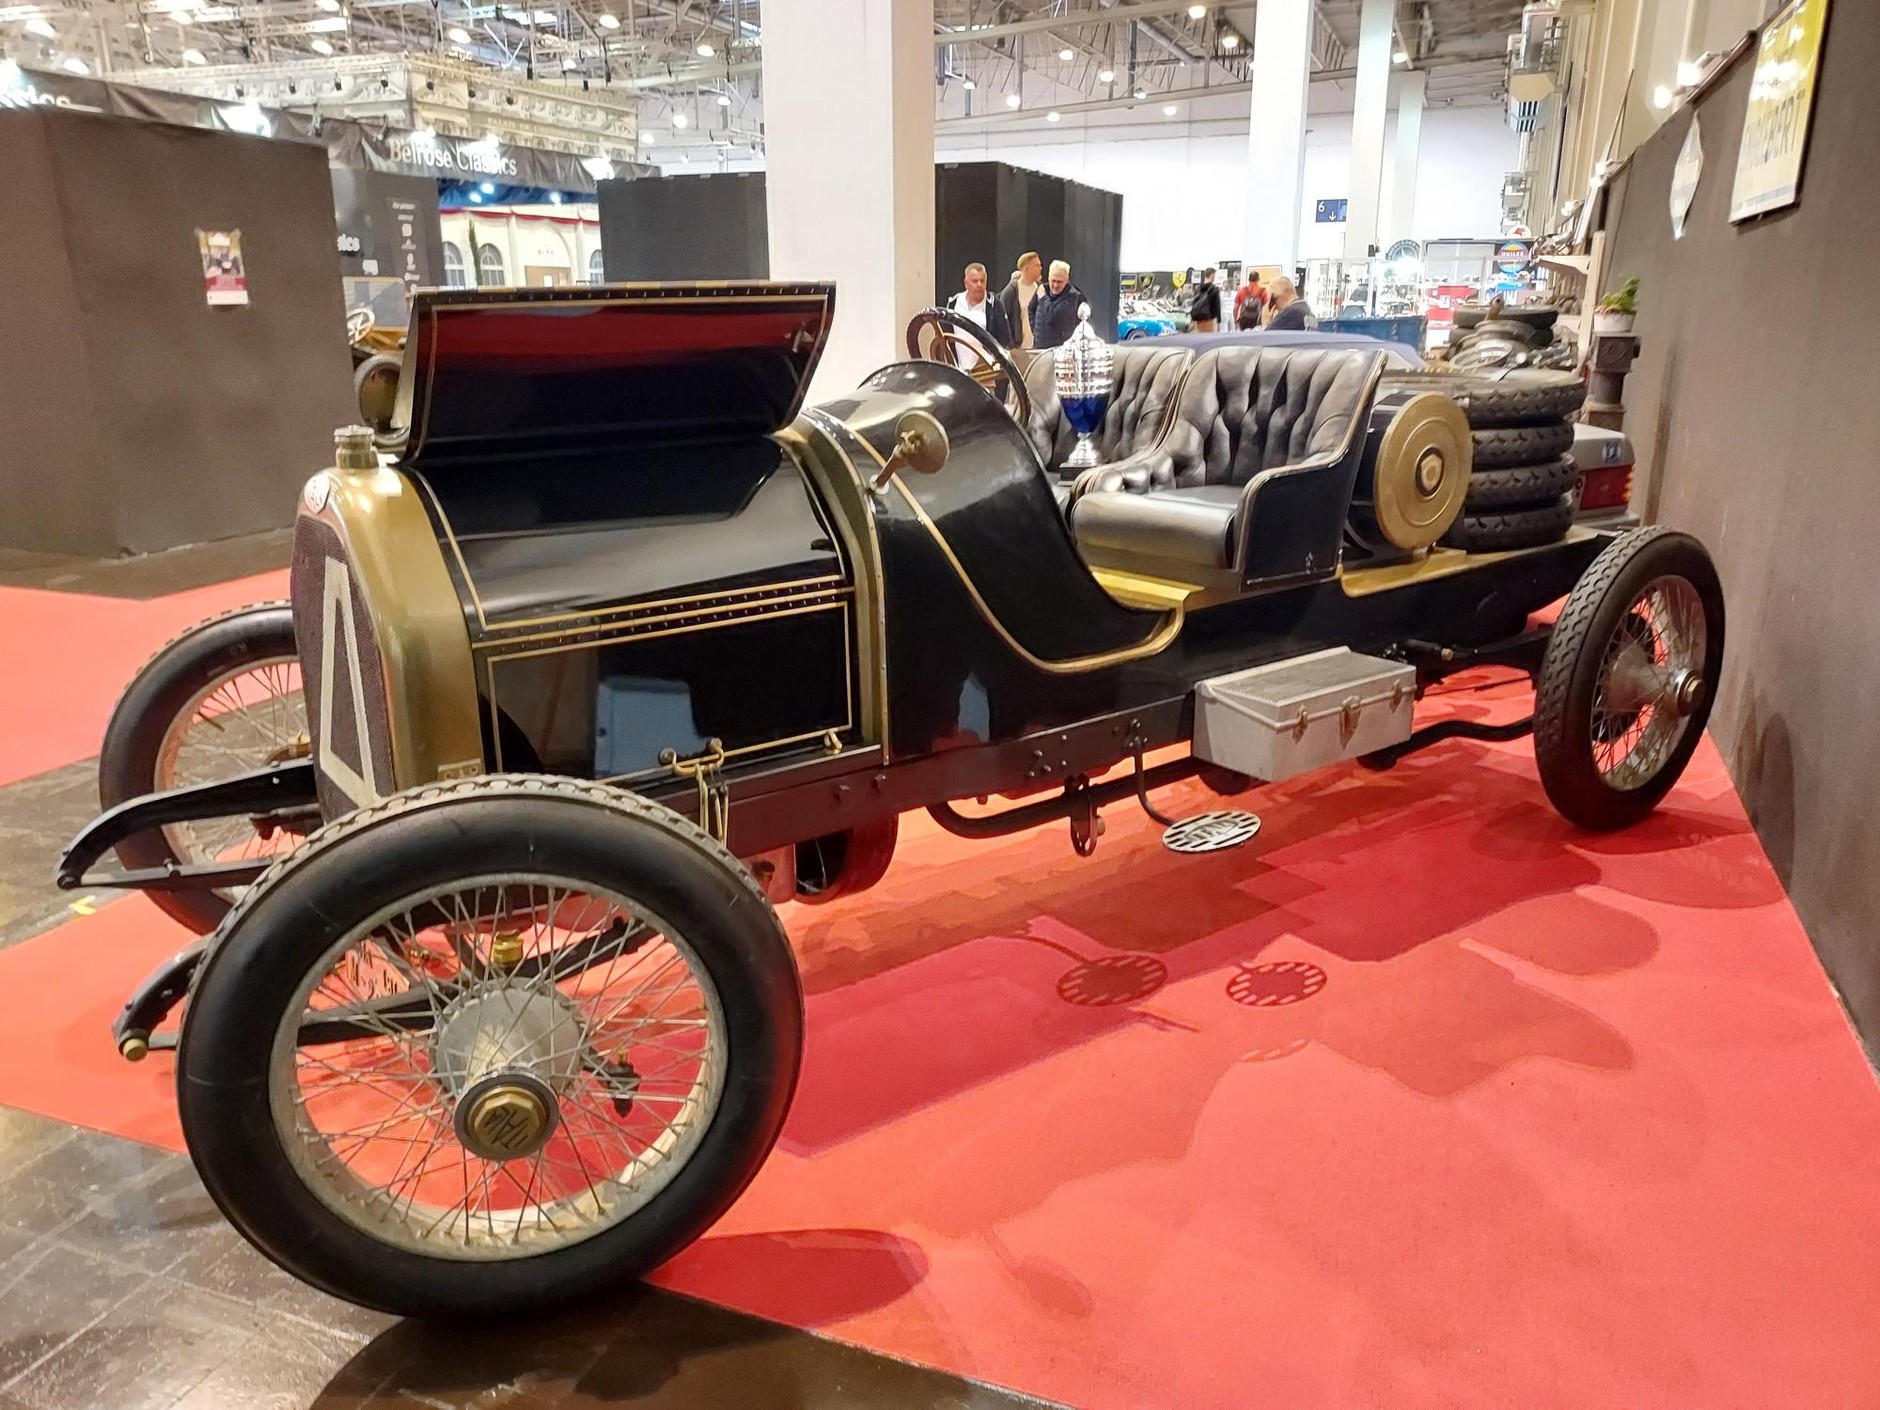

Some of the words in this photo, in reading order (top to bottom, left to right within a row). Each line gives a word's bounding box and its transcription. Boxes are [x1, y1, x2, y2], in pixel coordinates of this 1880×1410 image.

[388, 138, 453, 169] Belrose
[455, 142, 518, 176] Classics
[1318, 200, 1325, 213] 6
